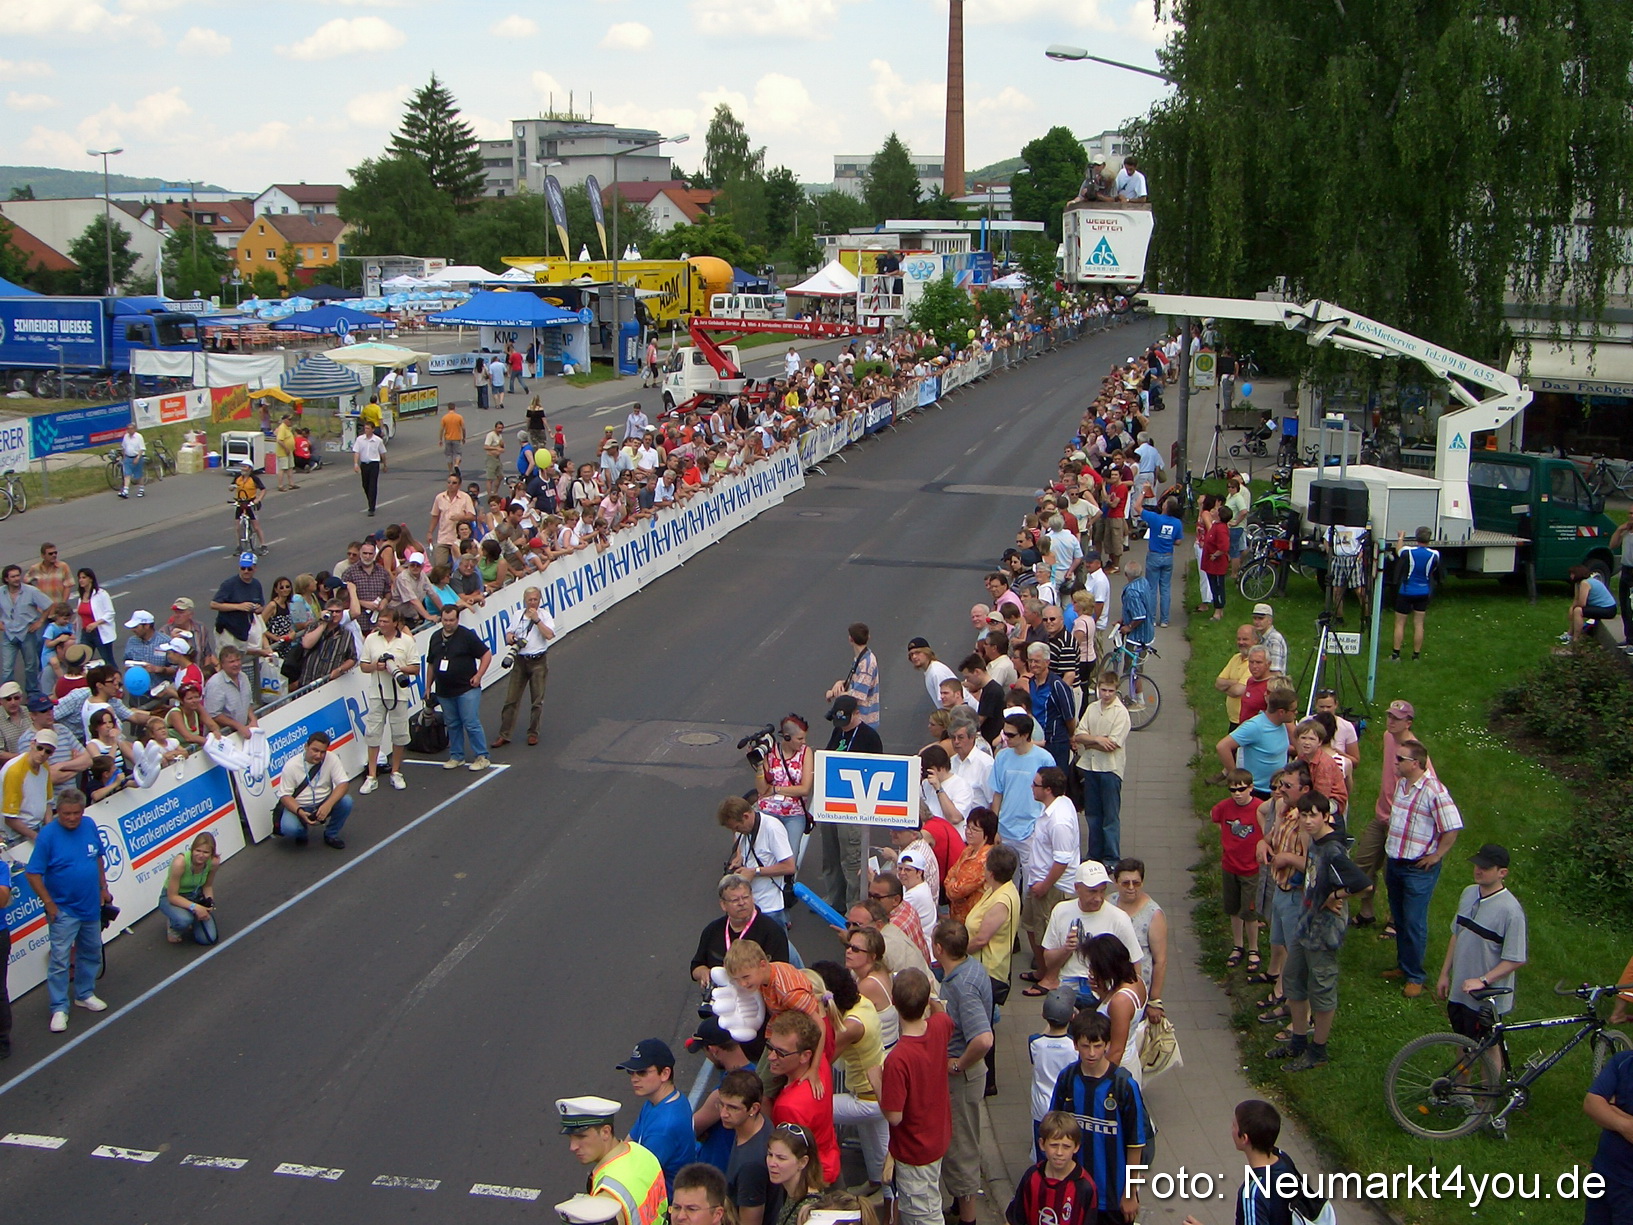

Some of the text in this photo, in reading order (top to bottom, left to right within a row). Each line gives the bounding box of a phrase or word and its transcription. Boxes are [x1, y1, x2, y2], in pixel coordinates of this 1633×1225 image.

[14, 319, 93, 334] SCHNEIDER WEISSE
[494, 331, 518, 344] KMP
[1353, 320, 1417, 351] JGS-Mietservice
[1473, 367, 1484, 378] 63
[1484, 372, 1495, 382] 52
[1541, 380, 1570, 391] Das
[262, 678, 280, 690] PC
[269, 724, 309, 754] üddeutsche
[123, 797, 180, 834] Süddeutsche
[817, 813, 916, 824] Volksbanken Raiffeisenbanken
[128, 797, 213, 852] Krankenversicherung
[135, 869, 151, 884] Wir
[4, 896, 45, 926] ersiche
[1077, 1120, 1118, 1135] RELLI
